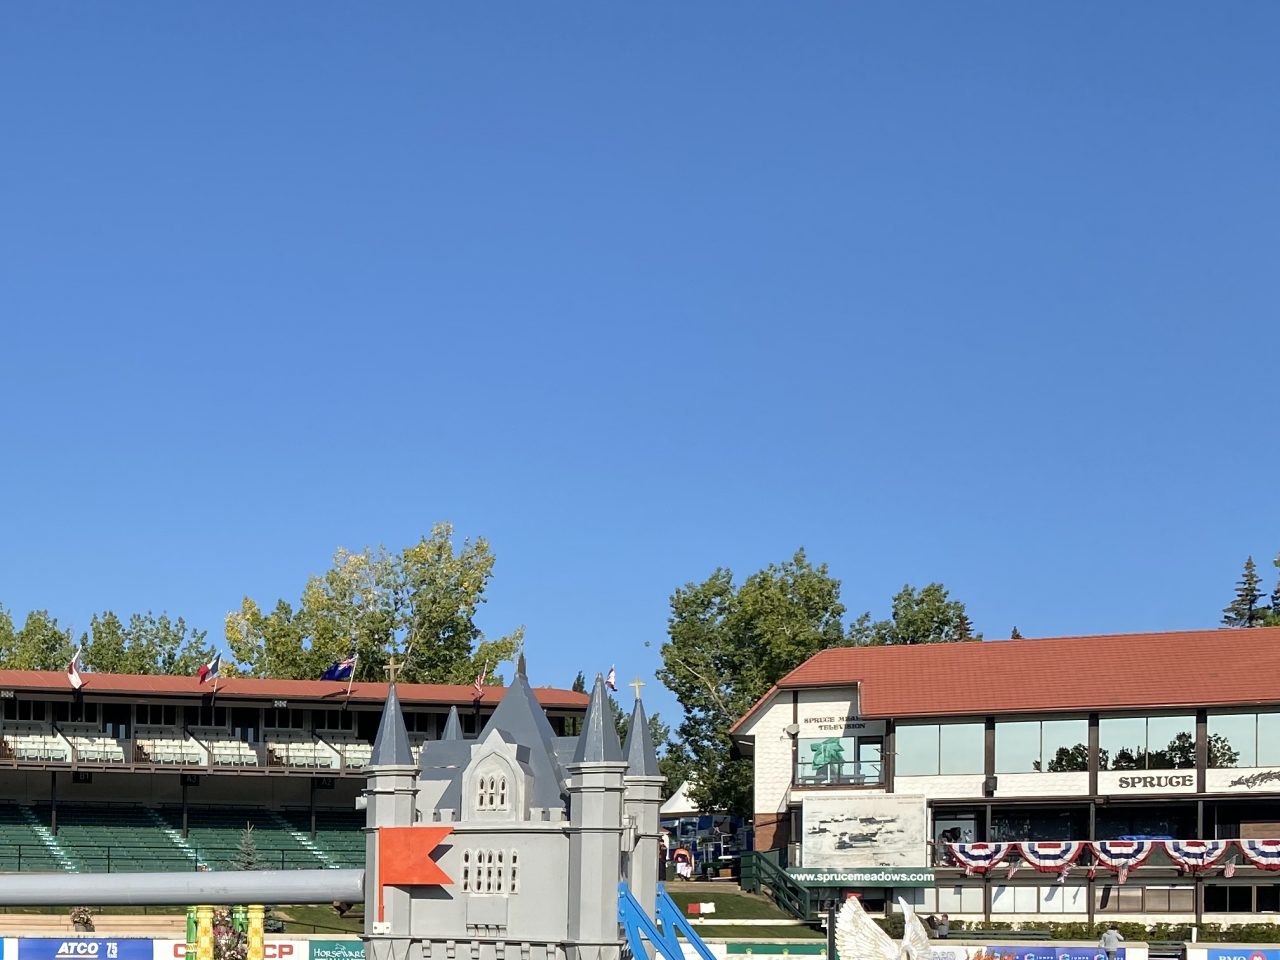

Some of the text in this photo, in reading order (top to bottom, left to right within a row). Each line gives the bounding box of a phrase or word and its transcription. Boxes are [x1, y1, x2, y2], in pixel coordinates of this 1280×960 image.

[803, 716, 835, 724] SPRUCE
[818, 723, 866, 731] TELEVISION
[1118, 774, 1194, 789] SPRUCE
[57, 942, 99, 954] ATCO
[106, 942, 118, 953] 75
[263, 944, 294, 958] CP
